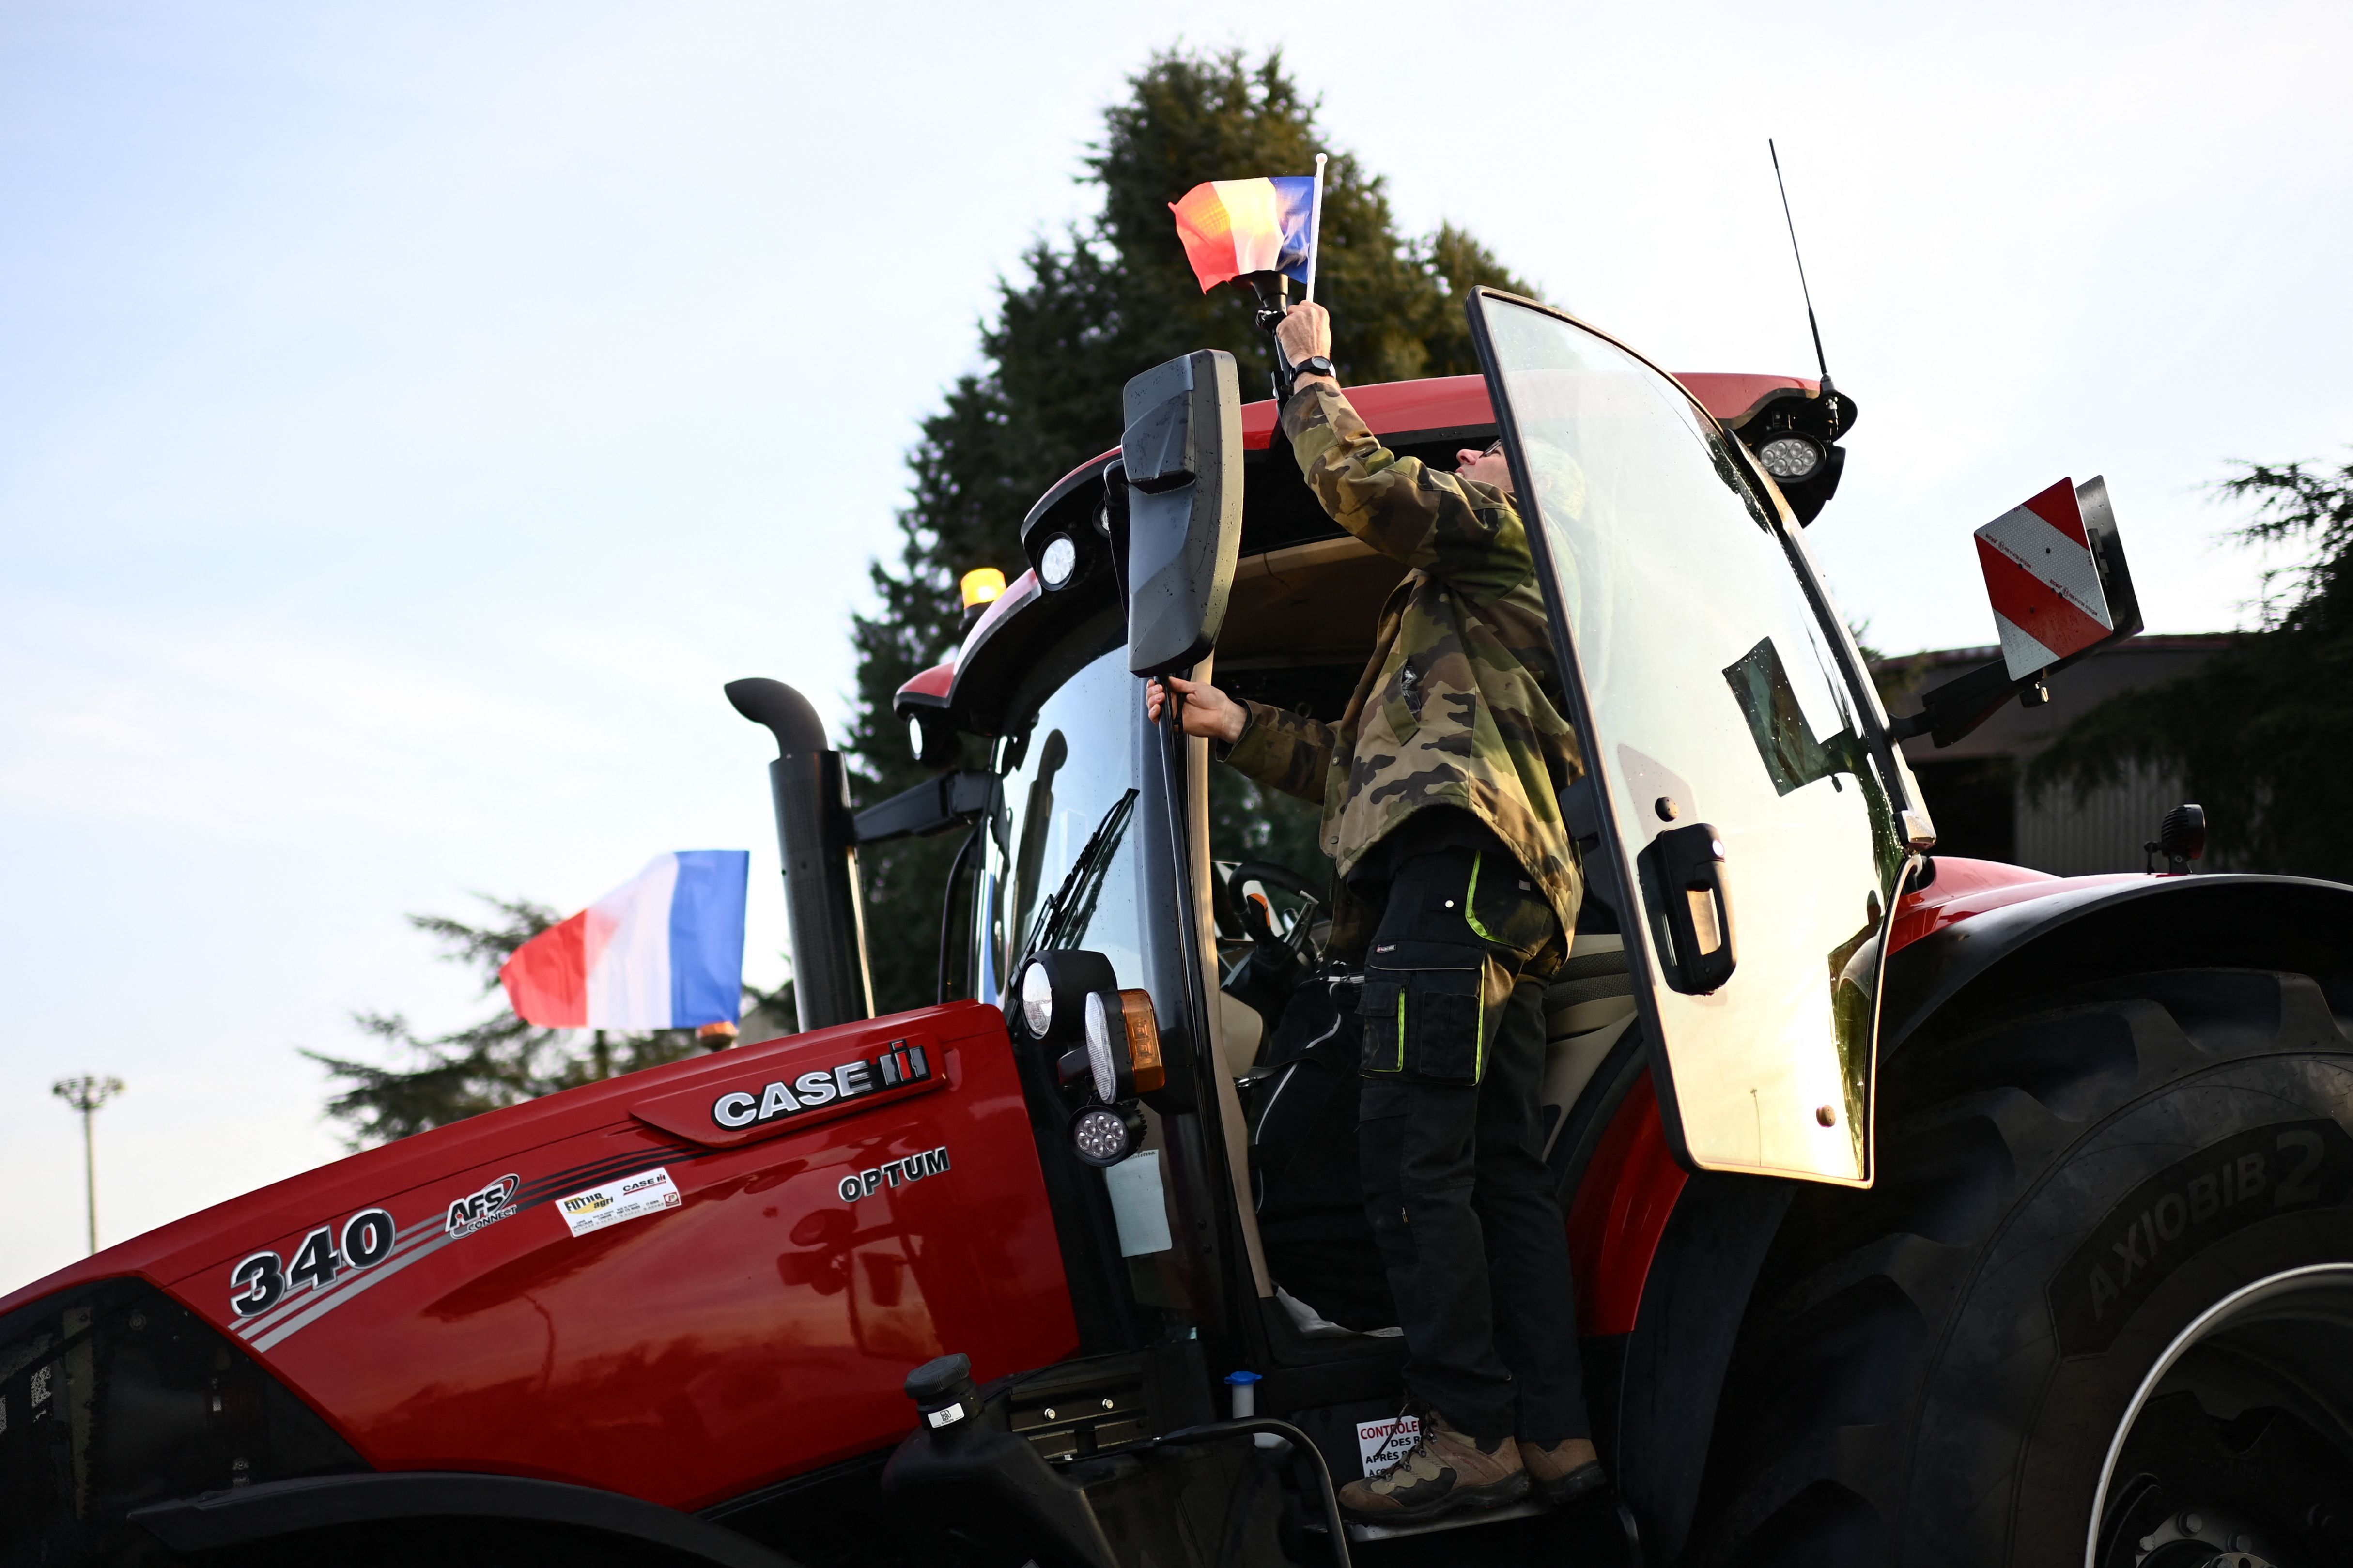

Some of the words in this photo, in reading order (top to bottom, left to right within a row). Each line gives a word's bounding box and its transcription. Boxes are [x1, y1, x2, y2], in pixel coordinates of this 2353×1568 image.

[713, 1060, 873, 1127] CASE
[622, 1178, 654, 1192] CASE
[838, 1146, 950, 1202] OPTUM
[447, 1184, 505, 1230] AFS
[468, 1205, 517, 1231] CONNECT
[593, 1196, 614, 1209] agri
[2089, 1153, 2267, 1322] AXIOBIB
[2274, 1130, 2324, 1208] 2
[229, 1207, 396, 1318] 340
[1365, 1451, 1399, 1464] APRÈS
[1391, 1437, 1411, 1447] DES
